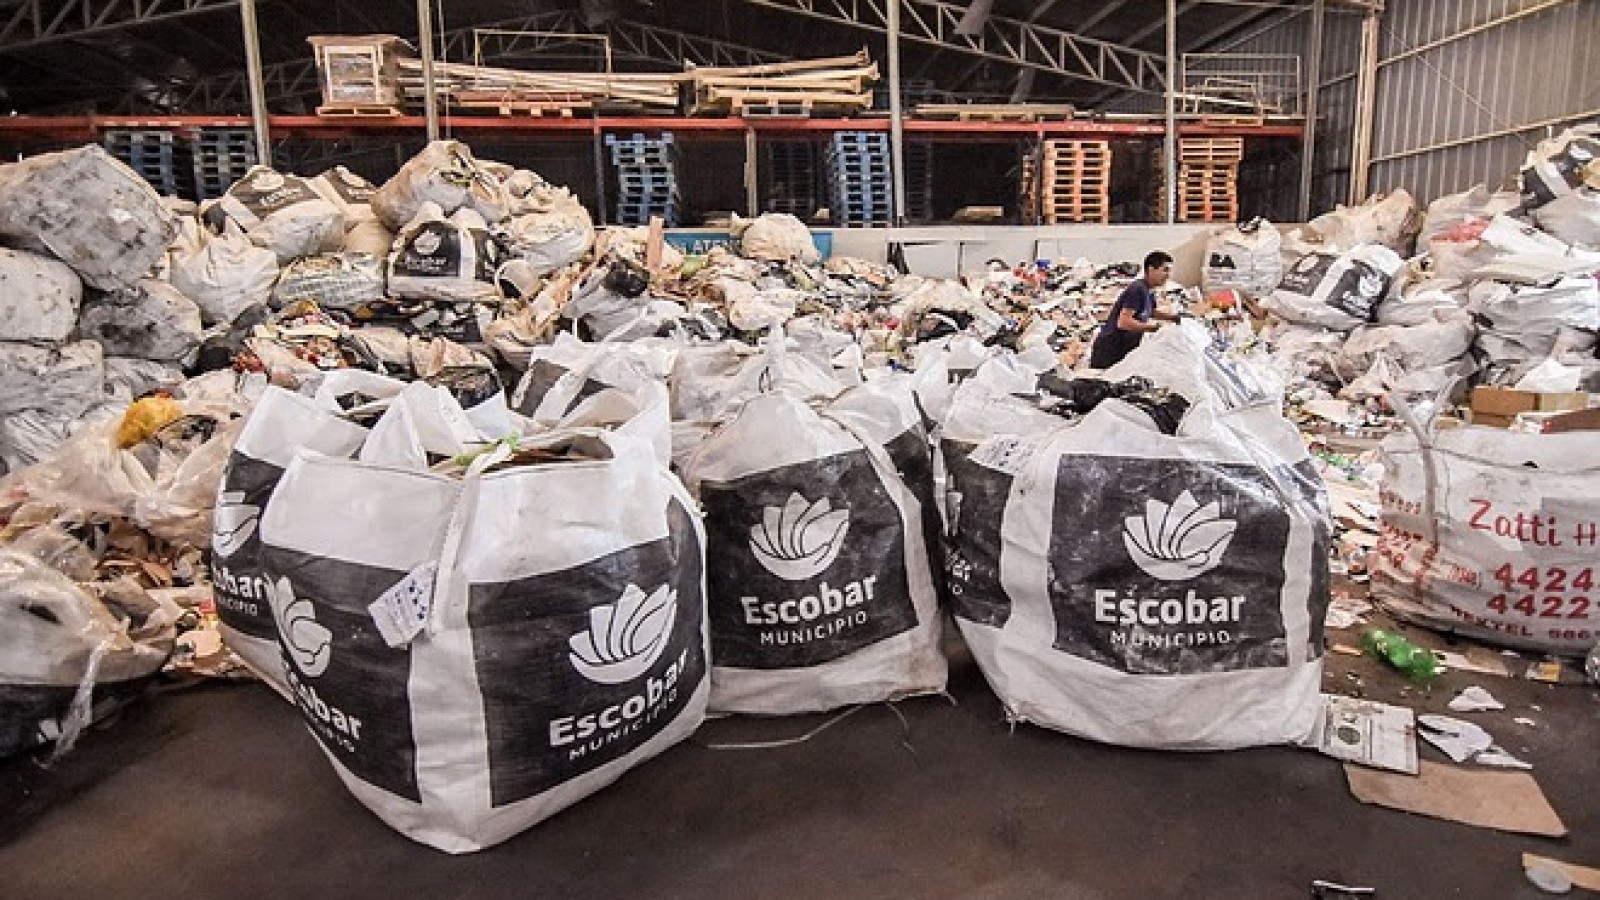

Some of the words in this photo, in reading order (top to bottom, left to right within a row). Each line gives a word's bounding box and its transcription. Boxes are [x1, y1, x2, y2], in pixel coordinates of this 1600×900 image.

[1469, 499, 1562, 547] Zatti
[1494, 563, 1600, 593] 4424
[740, 574, 877, 624] Escobar
[1095, 589, 1247, 624] Escobar
[1486, 594, 1600, 619] 4422
[760, 610, 867, 646] MUNICIPIO
[1109, 630, 1231, 649] MUNICIPIO
[549, 648, 689, 746] Escobar
